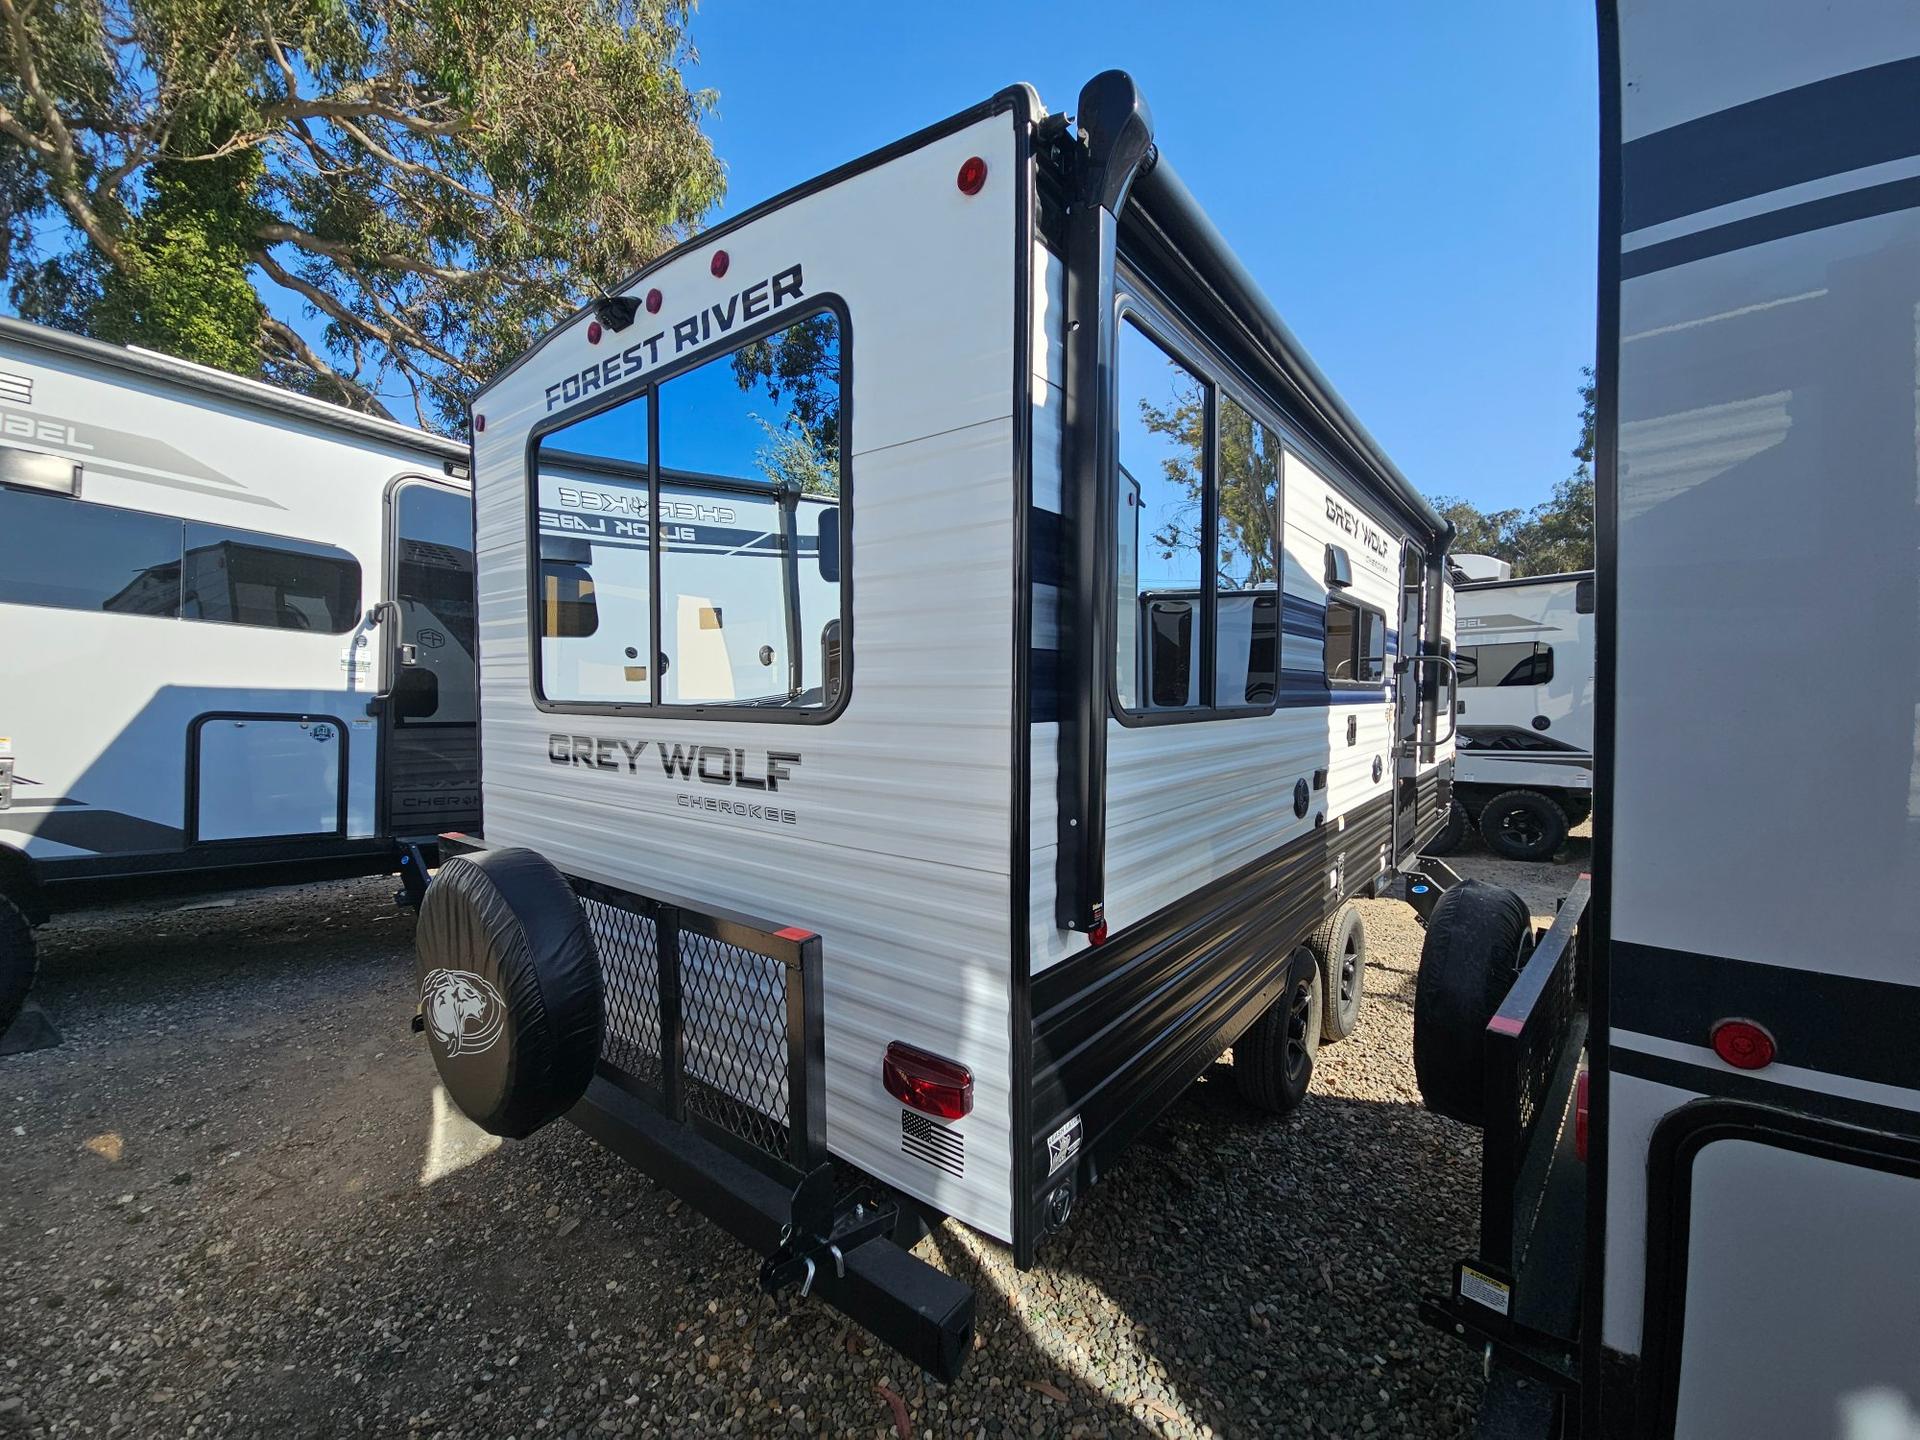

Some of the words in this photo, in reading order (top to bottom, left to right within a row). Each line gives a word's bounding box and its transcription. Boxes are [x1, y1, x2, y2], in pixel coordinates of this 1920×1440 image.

[545, 330, 665, 411] FOREST
[672, 263, 804, 353] RIVER
[0, 412, 94, 450] BEL
[1325, 495, 1359, 539] GREY
[1361, 522, 1388, 558] WOLF
[548, 733, 648, 774] GREY
[656, 742, 801, 792] WOLF
[676, 793, 797, 825] CHEROKEE
